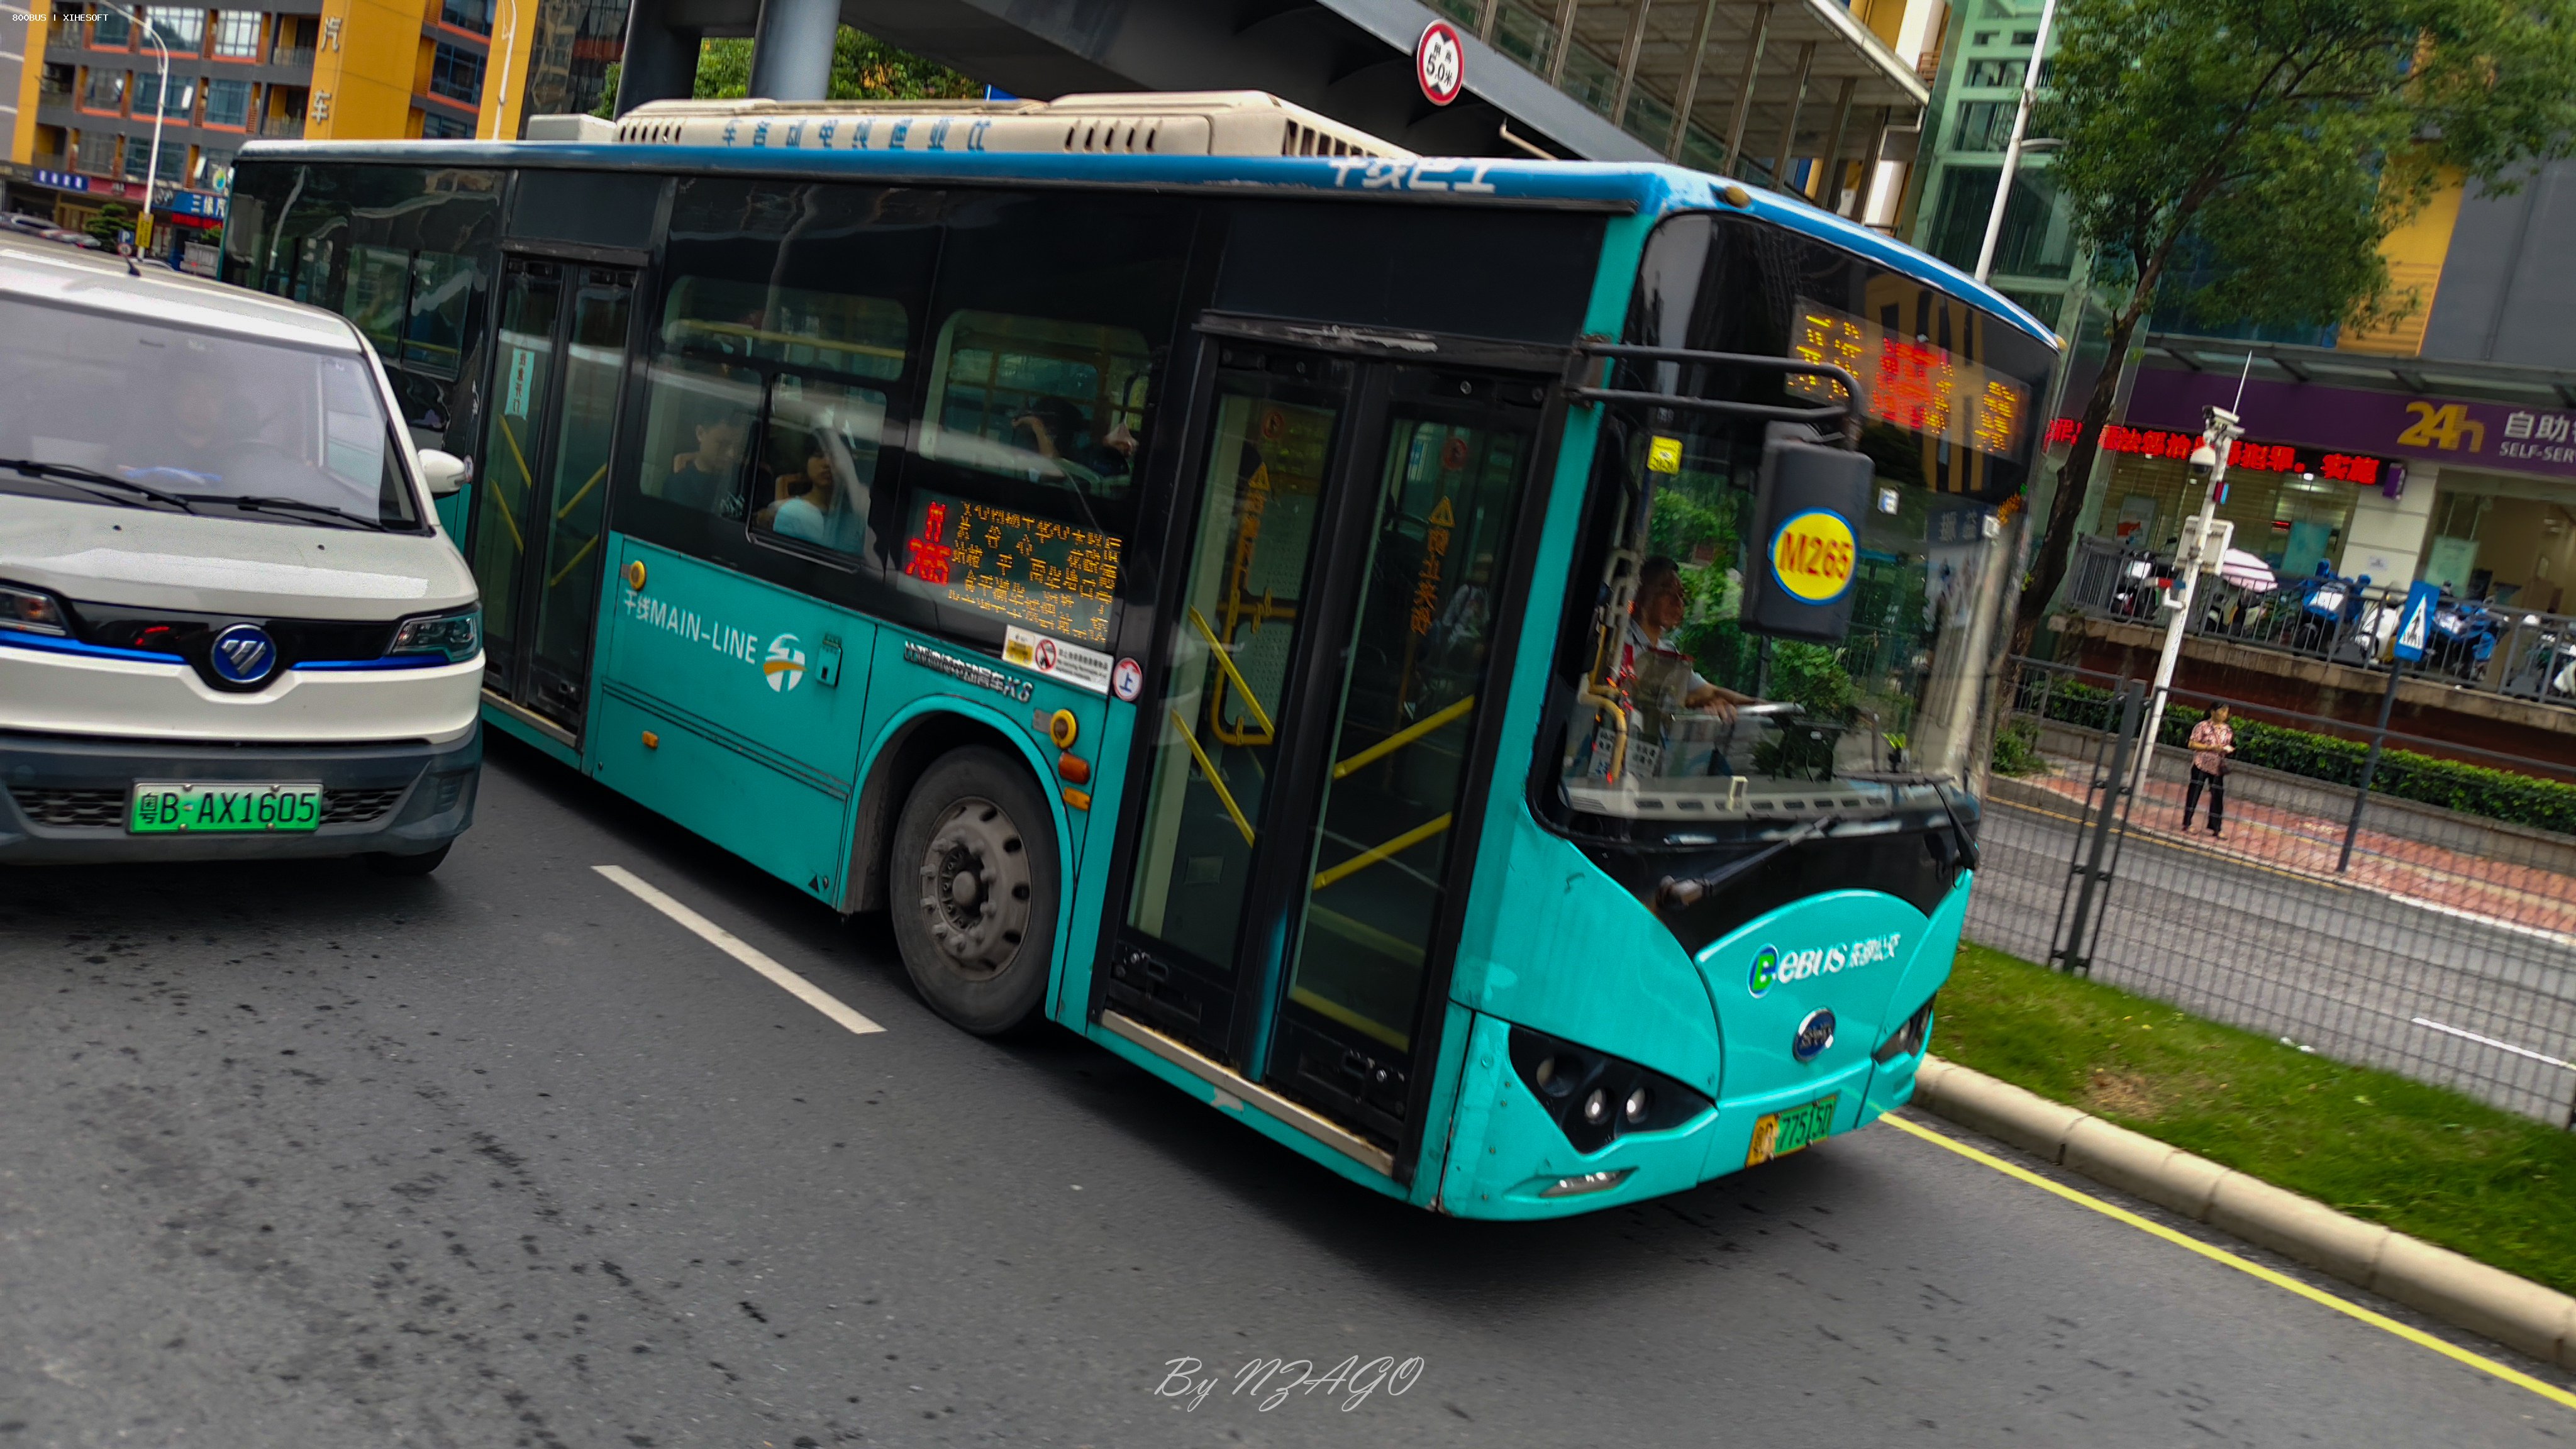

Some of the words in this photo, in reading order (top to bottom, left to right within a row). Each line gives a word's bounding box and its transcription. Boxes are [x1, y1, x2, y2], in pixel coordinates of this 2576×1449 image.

[2397, 401, 2485, 453] 24h
[2504, 411, 2576, 444] 自助
[1778, 531, 1853, 579] M265
